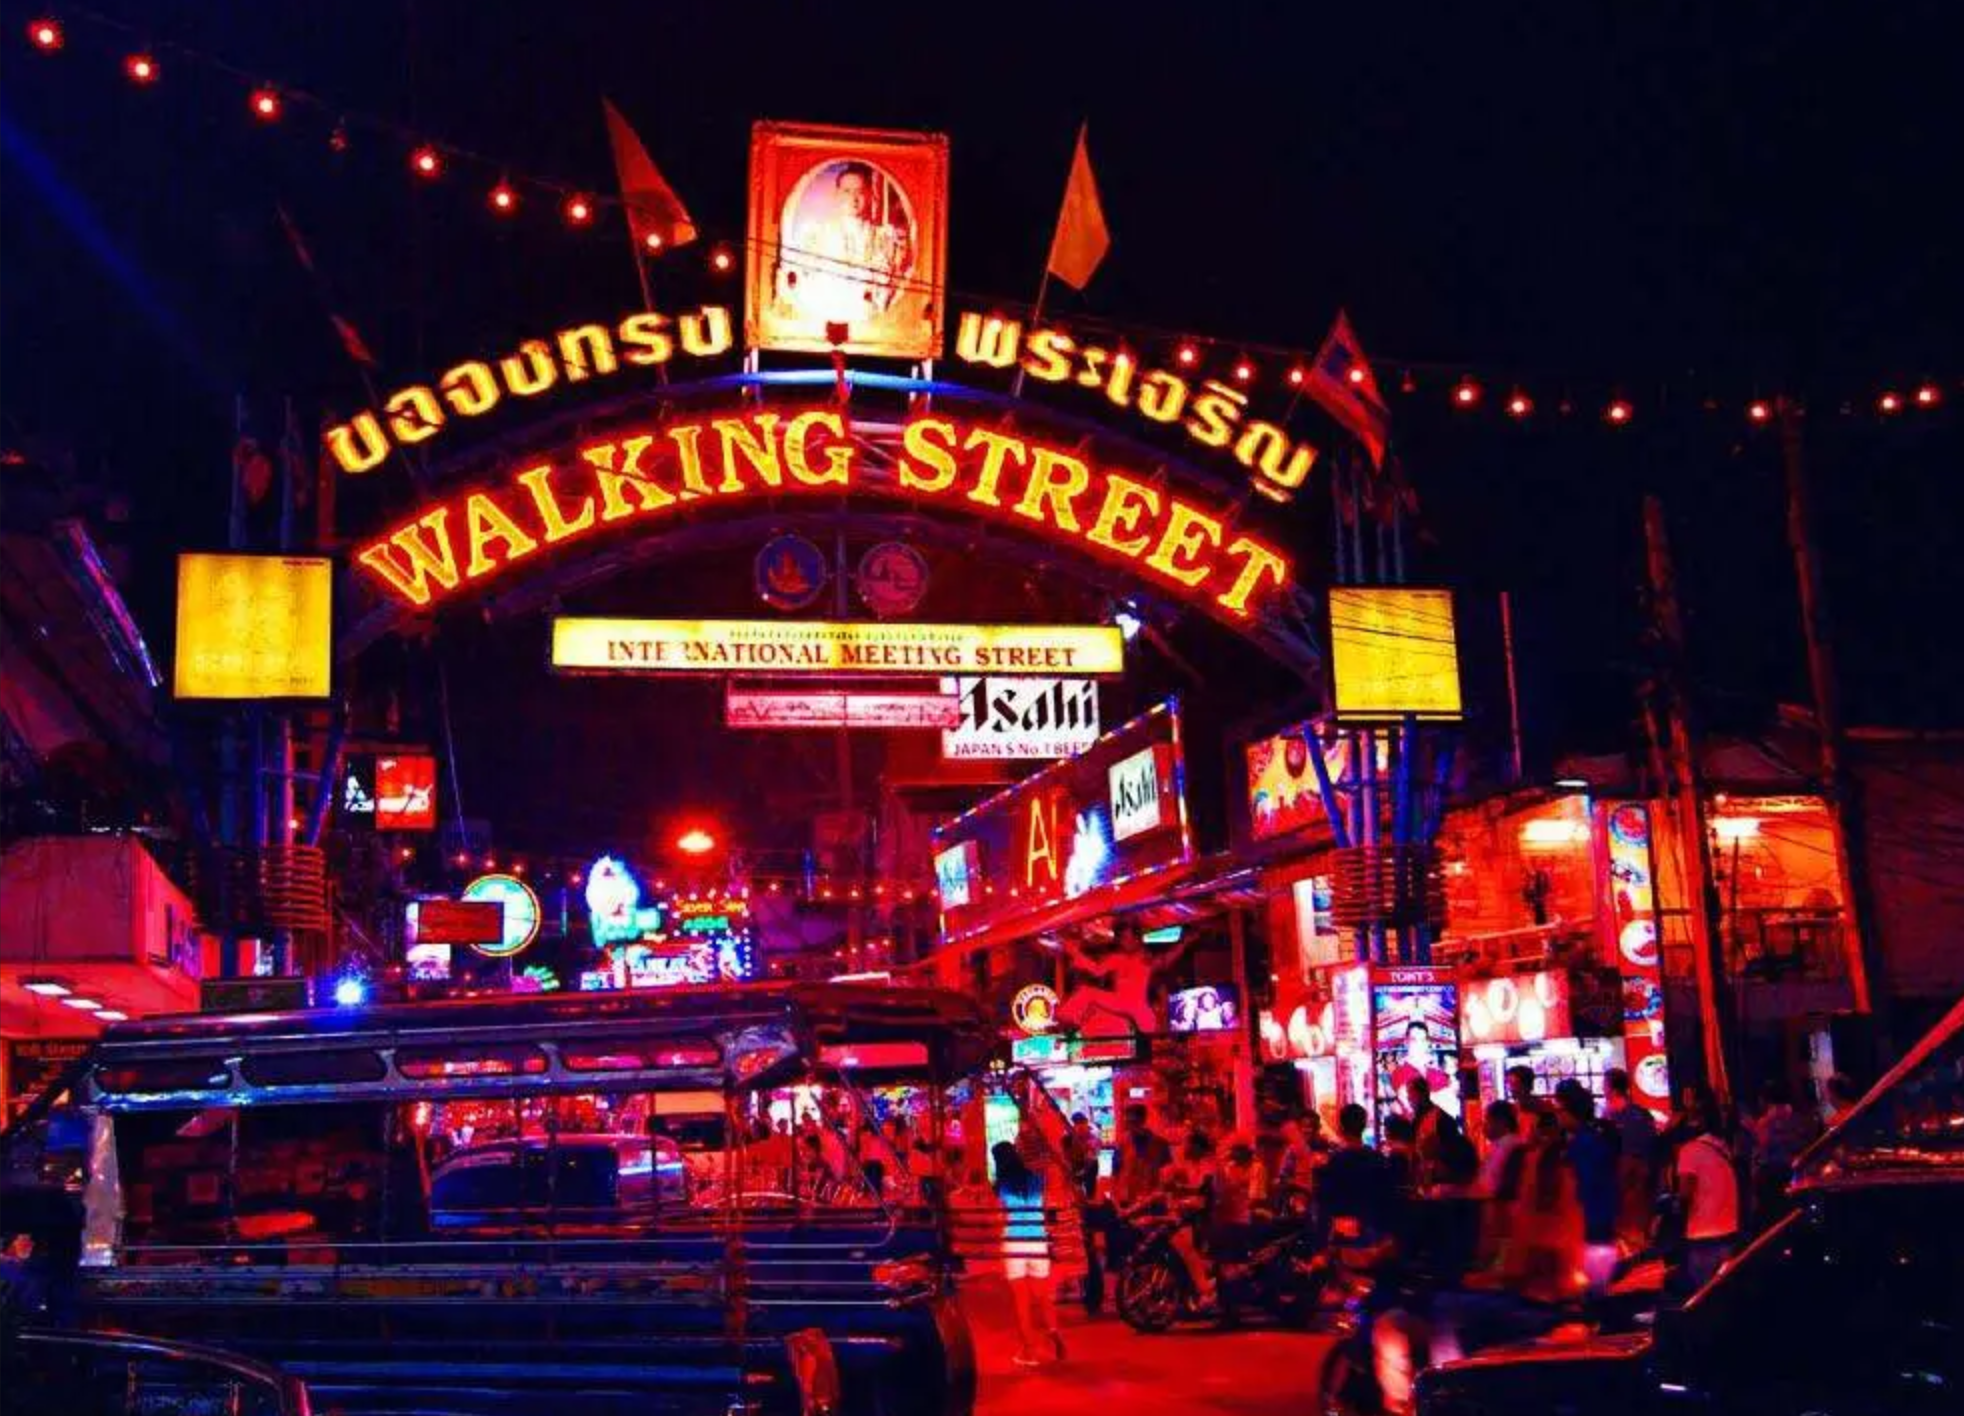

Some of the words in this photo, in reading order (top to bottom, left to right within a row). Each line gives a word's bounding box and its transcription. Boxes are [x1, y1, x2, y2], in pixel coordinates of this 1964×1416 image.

[359, 411, 854, 605] WALKING
[899, 418, 1286, 617] STREET
[841, 643, 961, 666] MEETING
[975, 646, 1077, 667] STREET
[948, 676, 1095, 732] Asahi
